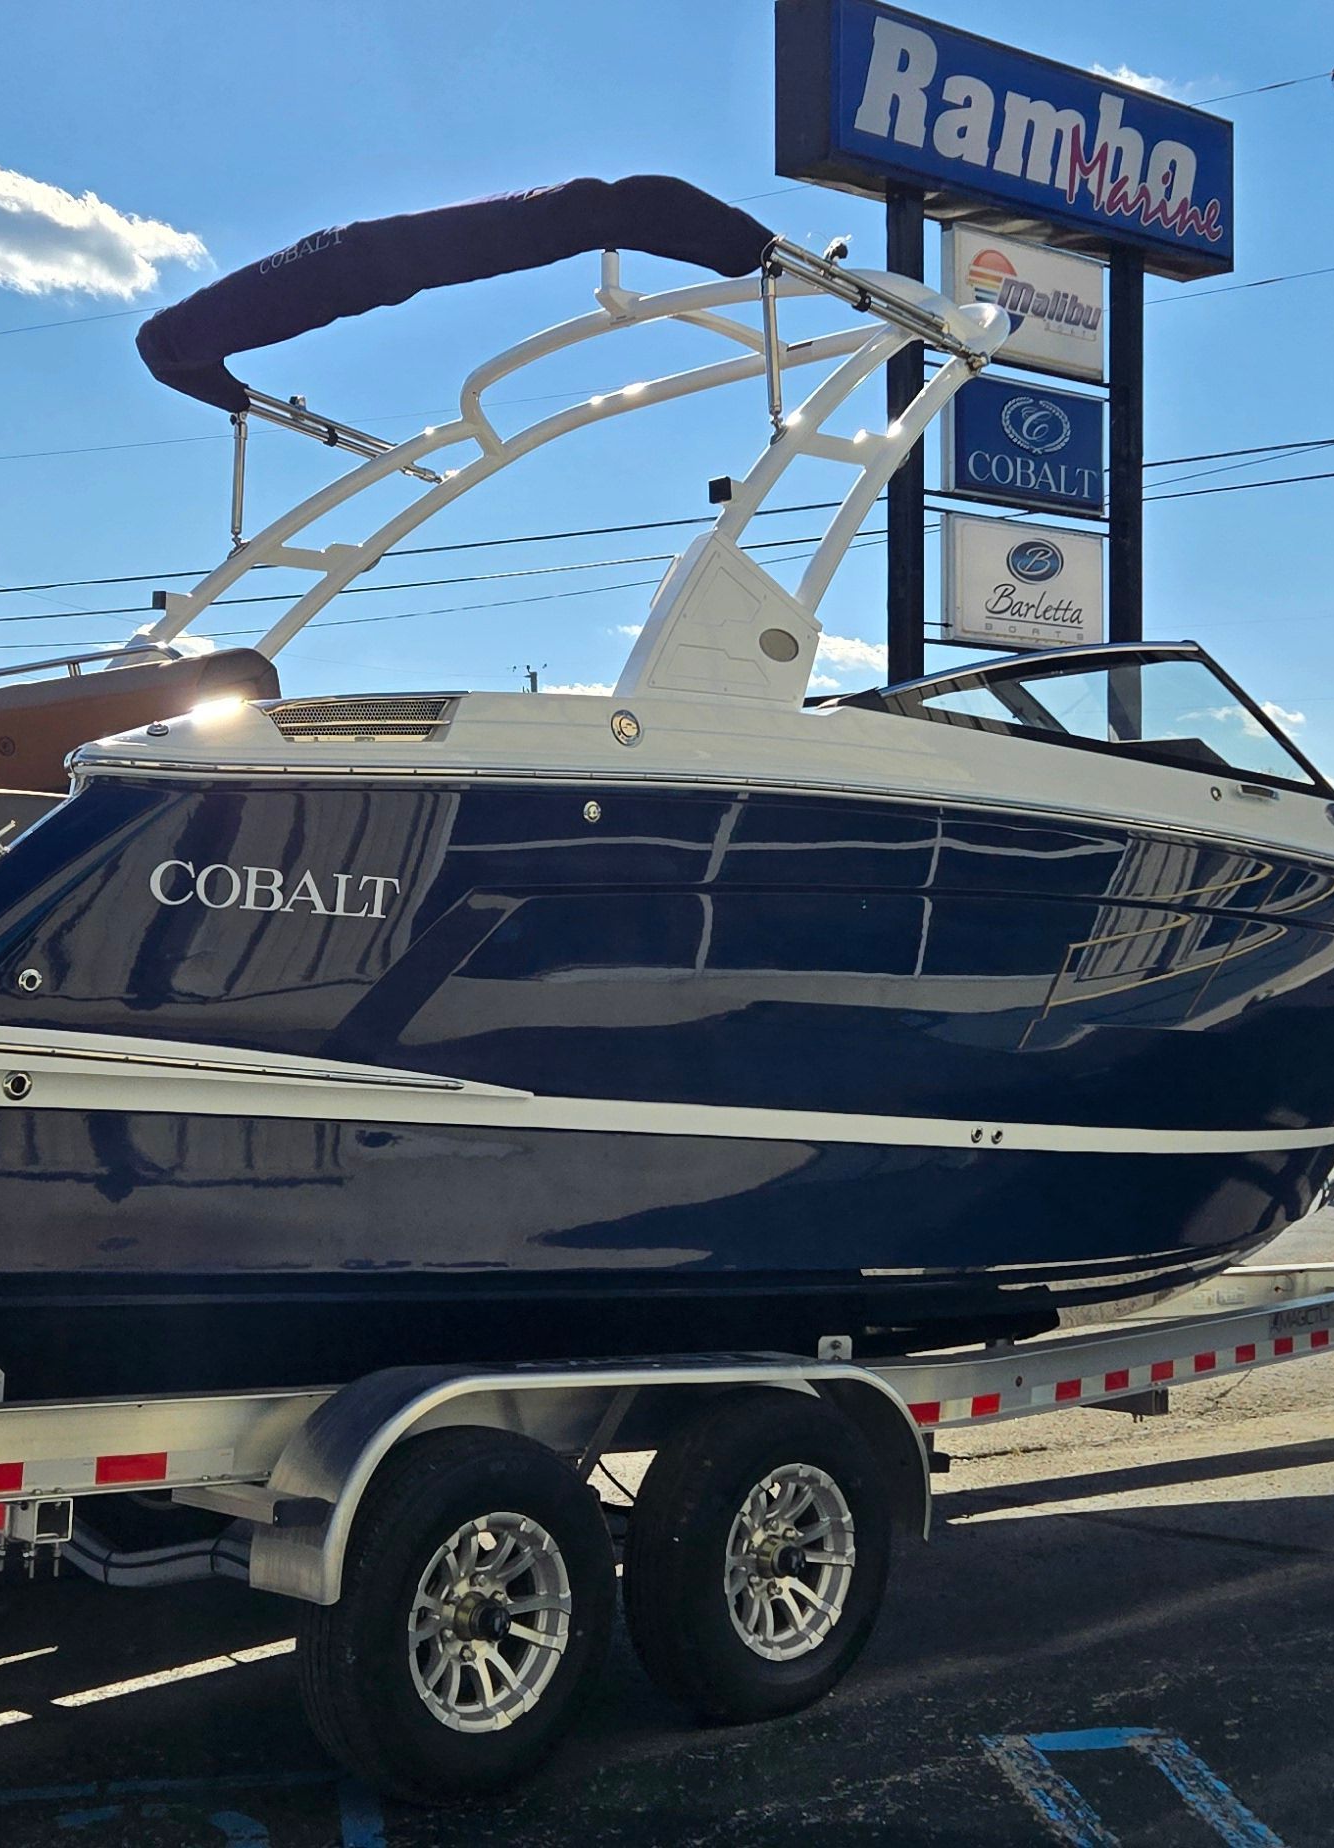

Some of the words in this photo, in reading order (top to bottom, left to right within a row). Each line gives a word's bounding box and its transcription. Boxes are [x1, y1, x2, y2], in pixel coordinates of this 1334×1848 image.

[854, 16, 1197, 210] Rambo
[1067, 123, 1223, 241] Marine
[259, 226, 347, 274] COBALT
[998, 278, 1102, 331] Malibu
[968, 450, 1098, 498] COBALT
[985, 583, 1084, 625] Barletta
[149, 859, 400, 919] COBALT
